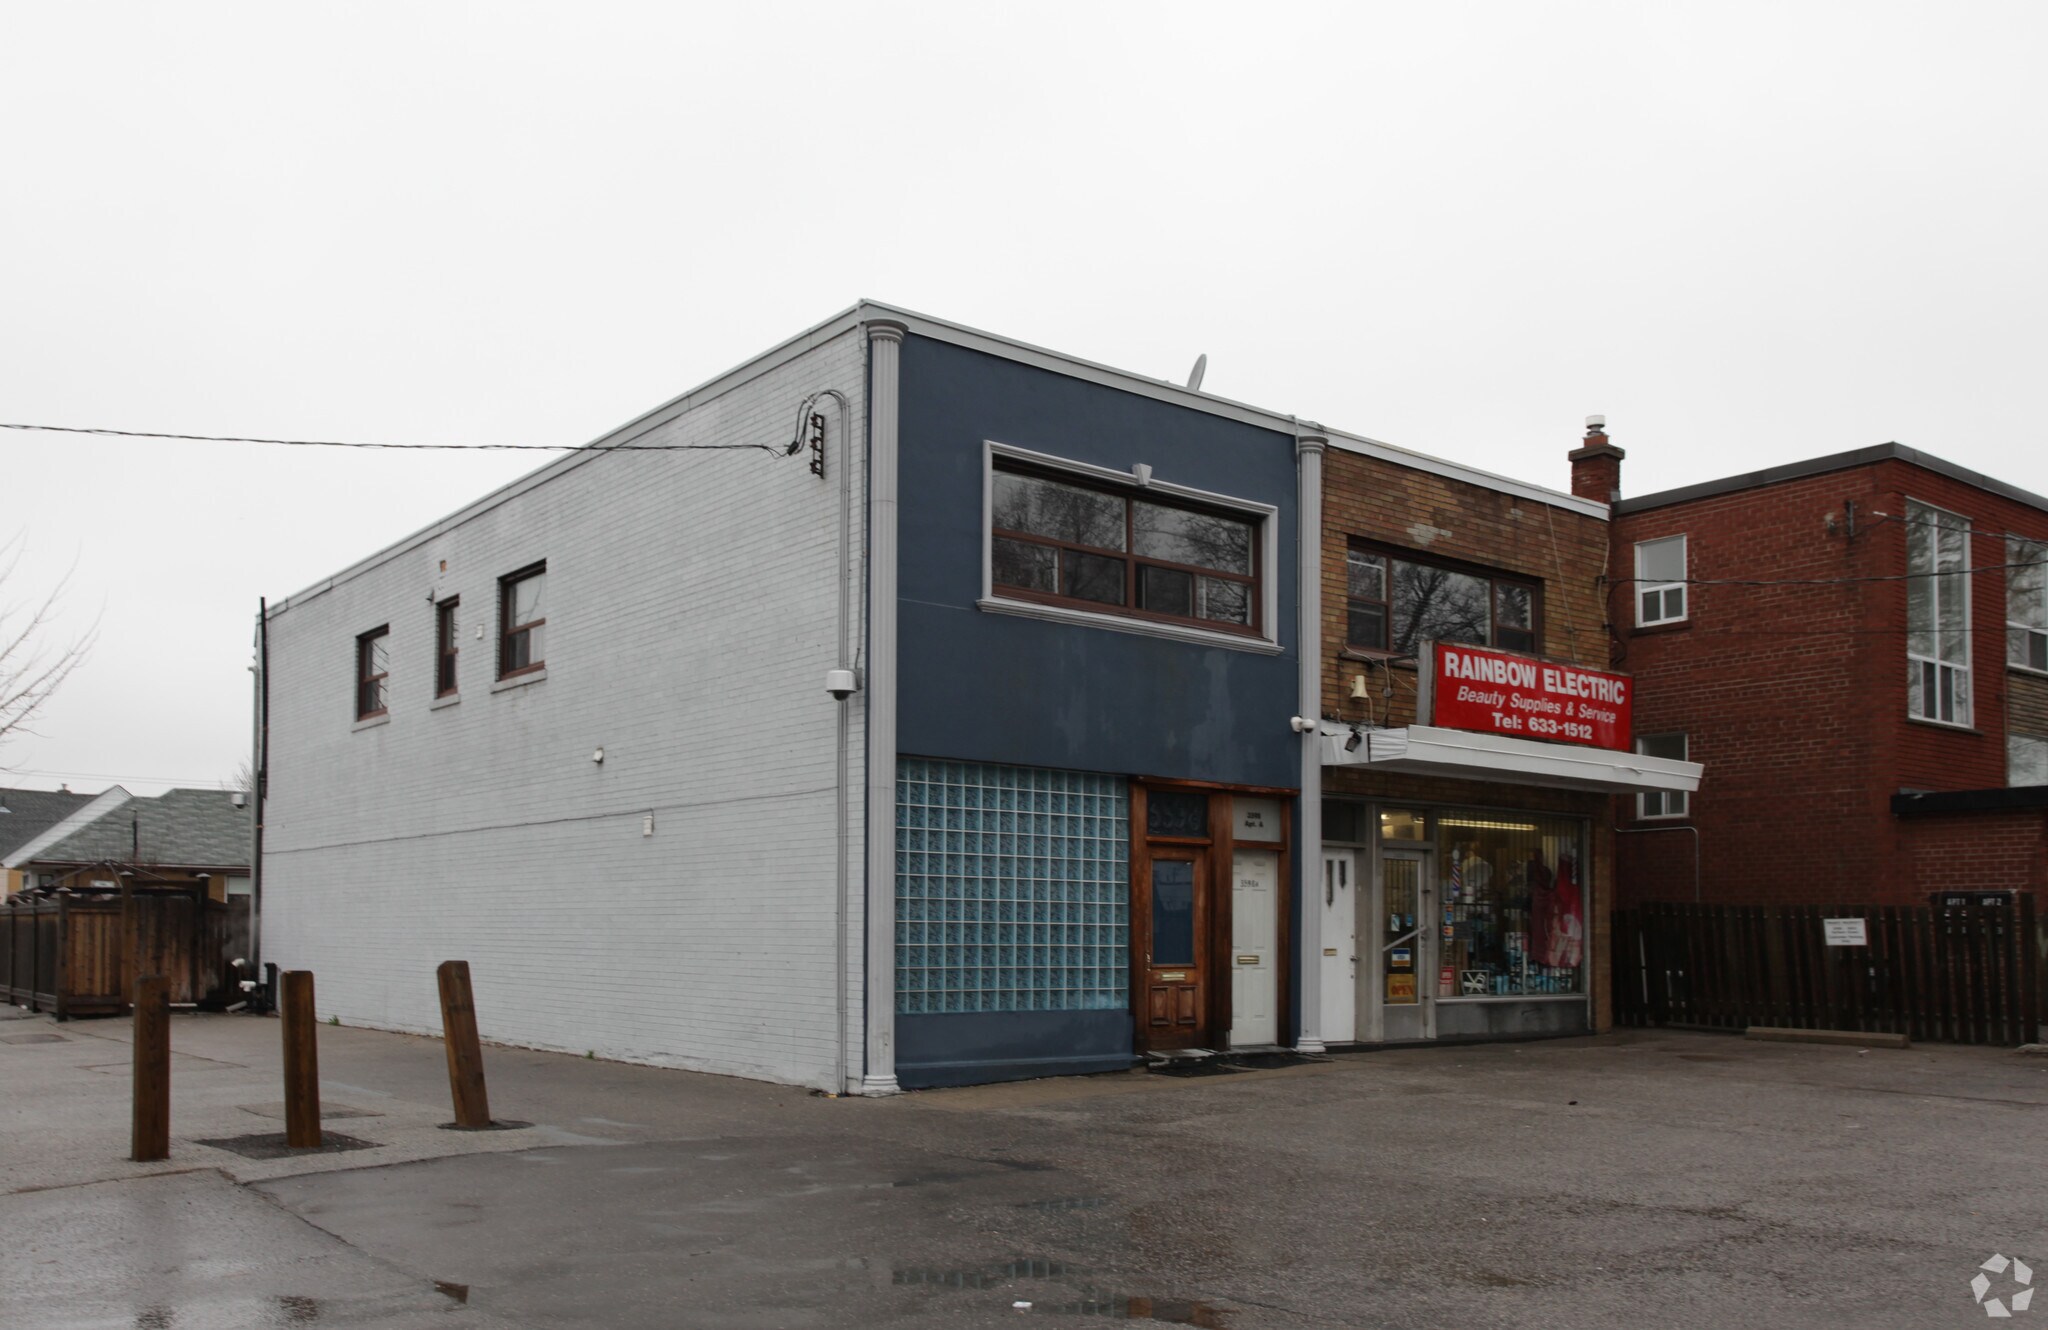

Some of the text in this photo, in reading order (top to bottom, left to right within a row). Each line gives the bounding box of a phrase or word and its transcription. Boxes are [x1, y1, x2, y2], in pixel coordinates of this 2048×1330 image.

[1444, 651, 1625, 705] RAINBOW ELECTRIC
[1457, 686, 1616, 723] Beauty Supplies & Service
[1492, 712, 1593, 740] Tel: 633-1512
